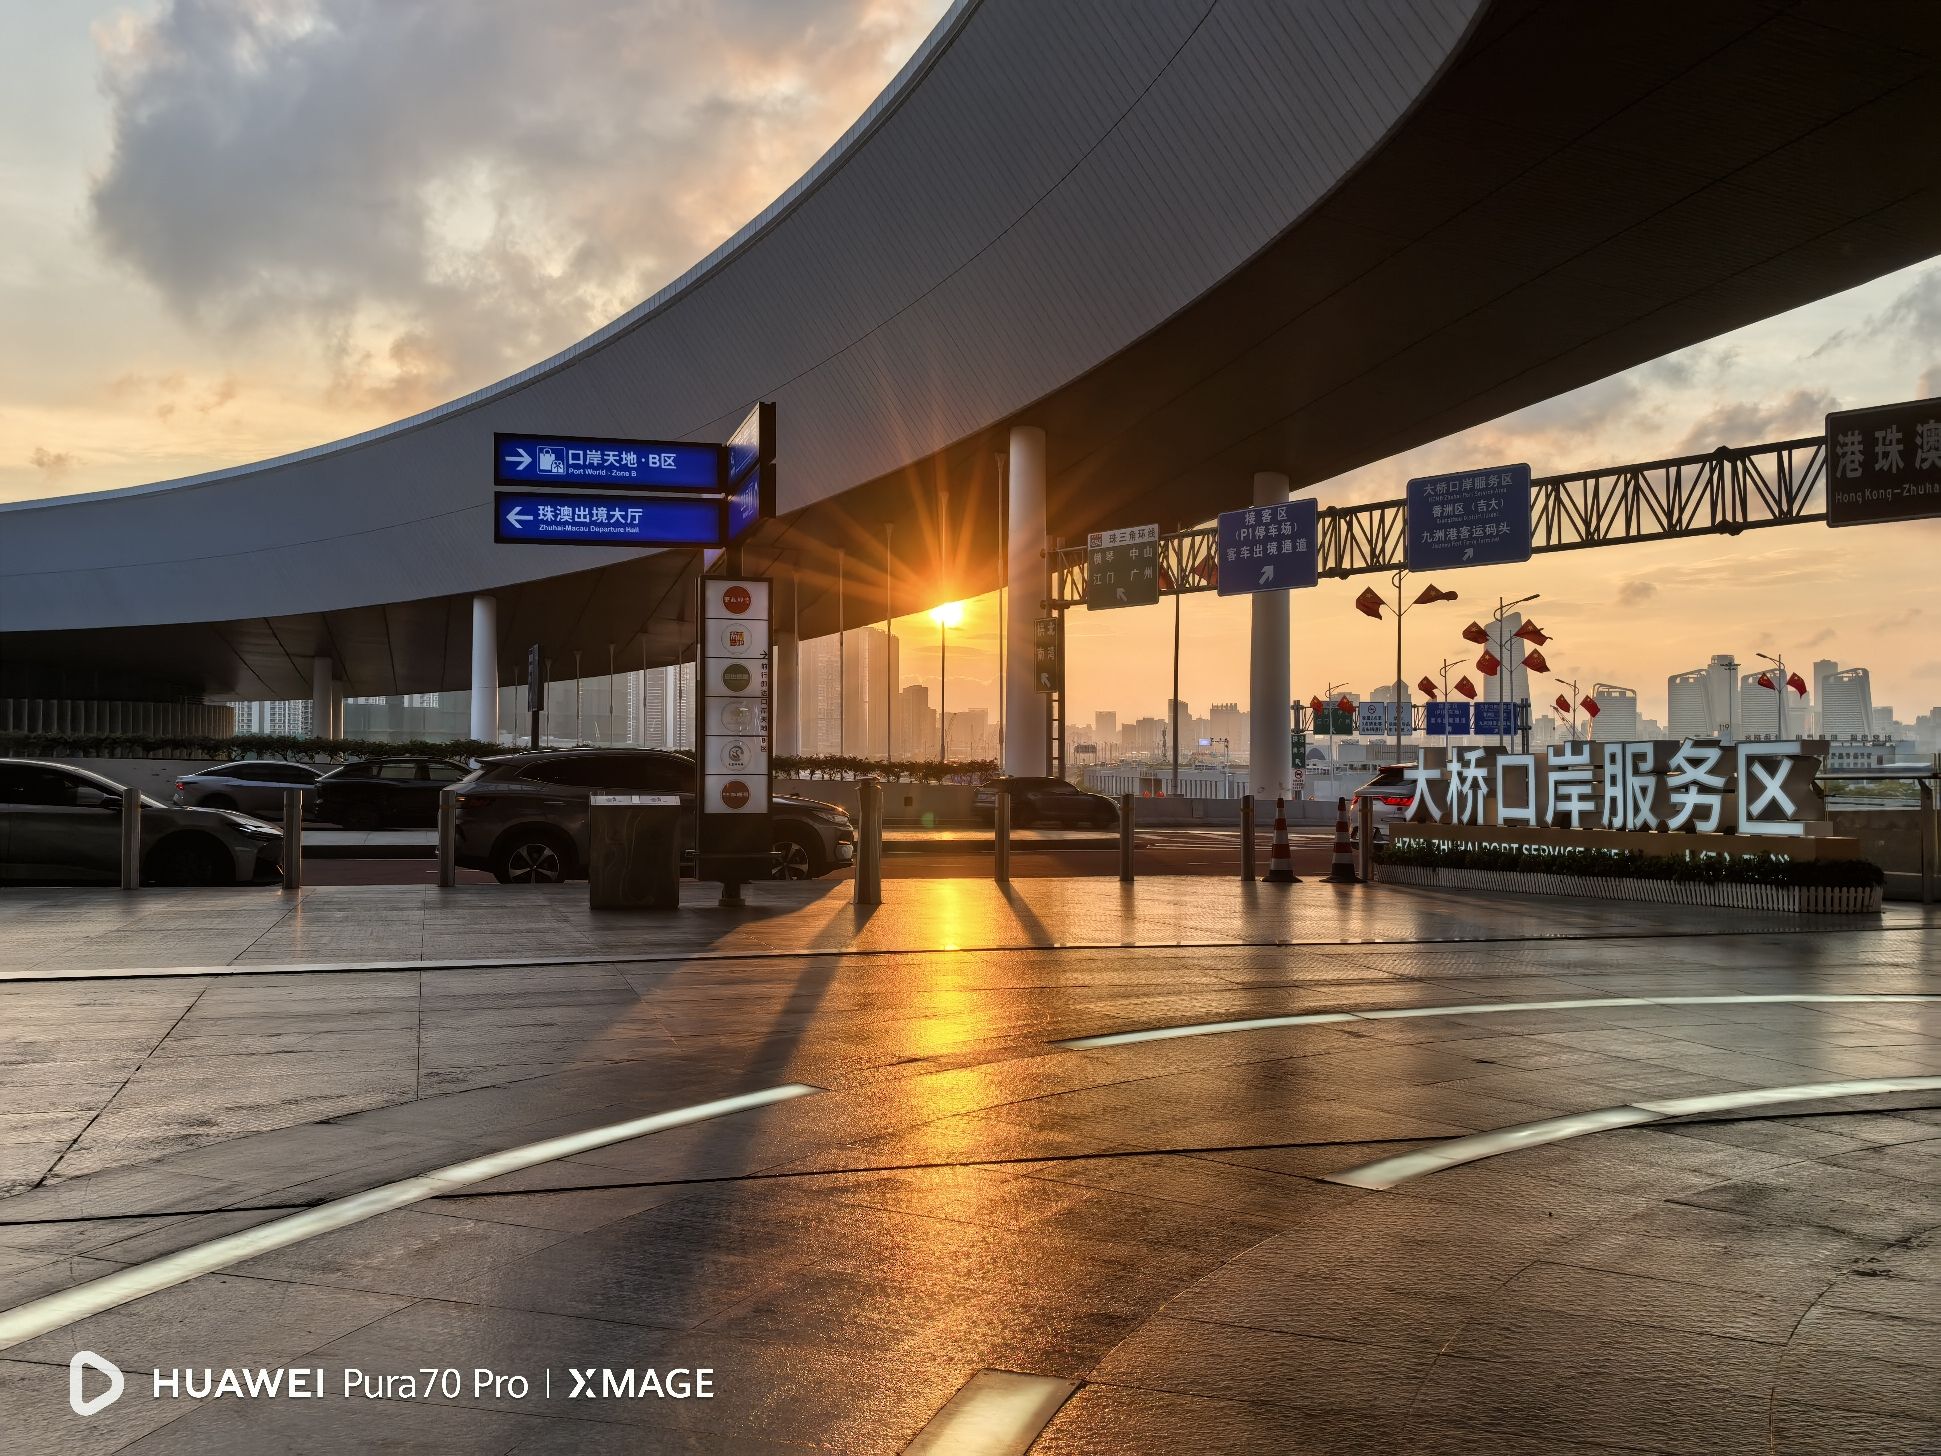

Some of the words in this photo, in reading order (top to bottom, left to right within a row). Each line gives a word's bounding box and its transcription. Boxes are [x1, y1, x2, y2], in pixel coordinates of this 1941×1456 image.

[568, 449, 677, 469] 口岸天地·B区
[1835, 420, 1941, 478] 港珠澳
[568, 467, 584, 475] Port
[585, 468, 606, 476] World
[611, 469, 630, 477] Zone
[1423, 473, 1513, 497] 大桥口岸服务区
[537, 505, 643, 524] 珠澳出境大厅
[1244, 506, 1288, 526] 接客区
[539, 524, 589, 532] Zhuhai-Macau
[590, 525, 625, 533] Departure
[1108, 527, 1156, 544] 珠三角环线
[1421, 521, 1511, 543] 九洲港客运码头
[1129, 545, 1153, 561] 中山
[1226, 538, 1307, 562] 客车出境通道
[1093, 571, 1115, 585] 江门
[1130, 566, 1153, 581] 广州
[1403, 738, 1805, 835] 大桥口岸服务区
